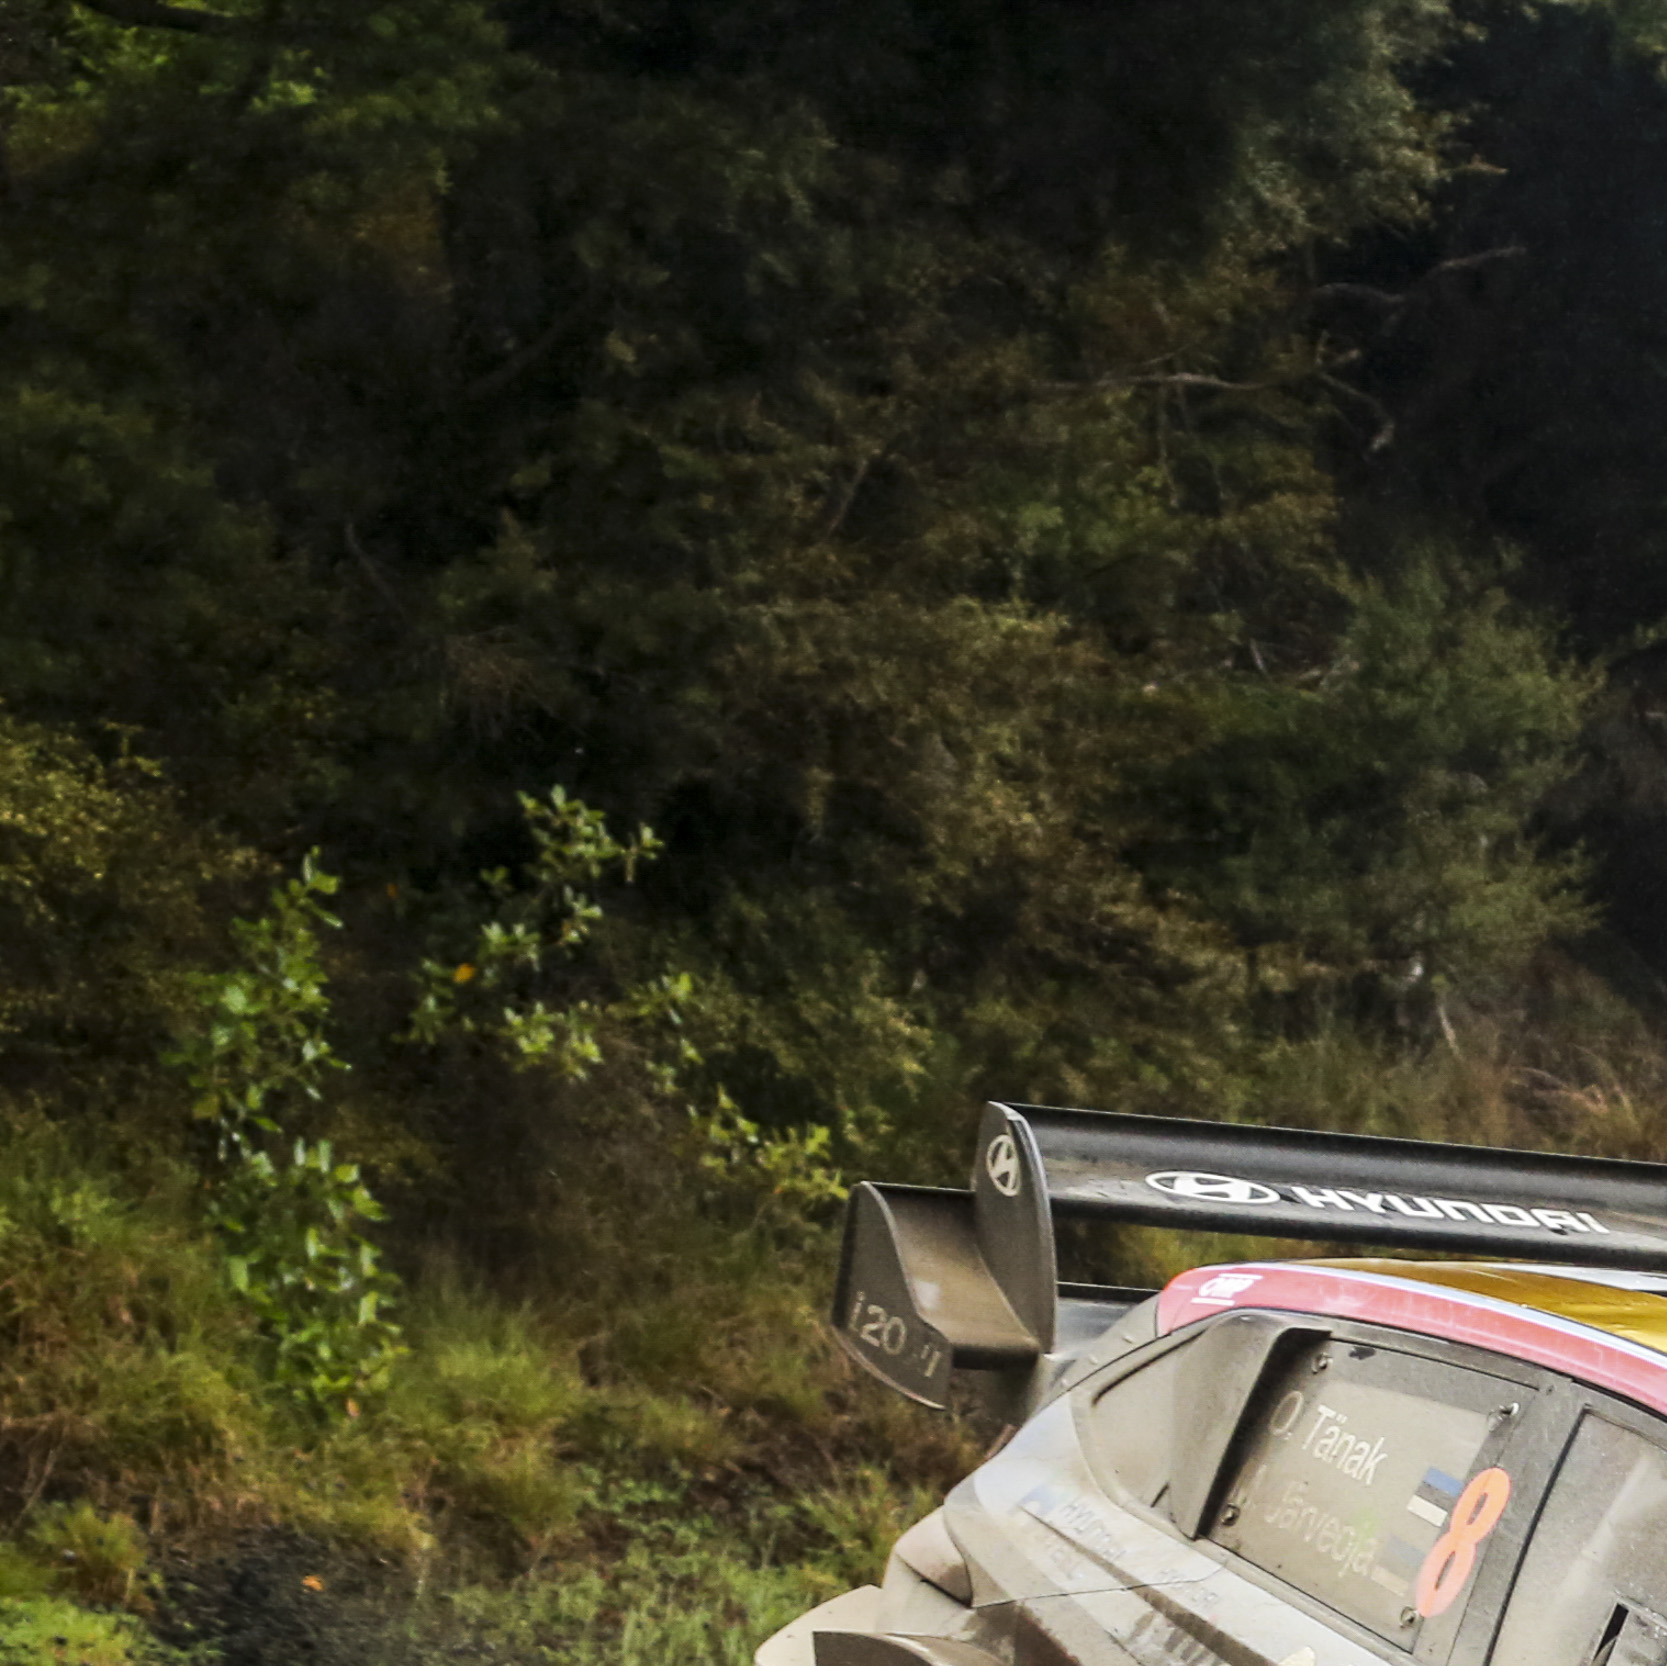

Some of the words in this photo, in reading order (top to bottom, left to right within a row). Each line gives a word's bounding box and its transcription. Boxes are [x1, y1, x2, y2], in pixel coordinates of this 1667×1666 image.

[1291, 1186, 1610, 1235] HYUNDAI
[848, 1290, 907, 1355] i20
[1302, 1403, 1388, 1486] Tänak
[1416, 1467, 1512, 1618] 8
